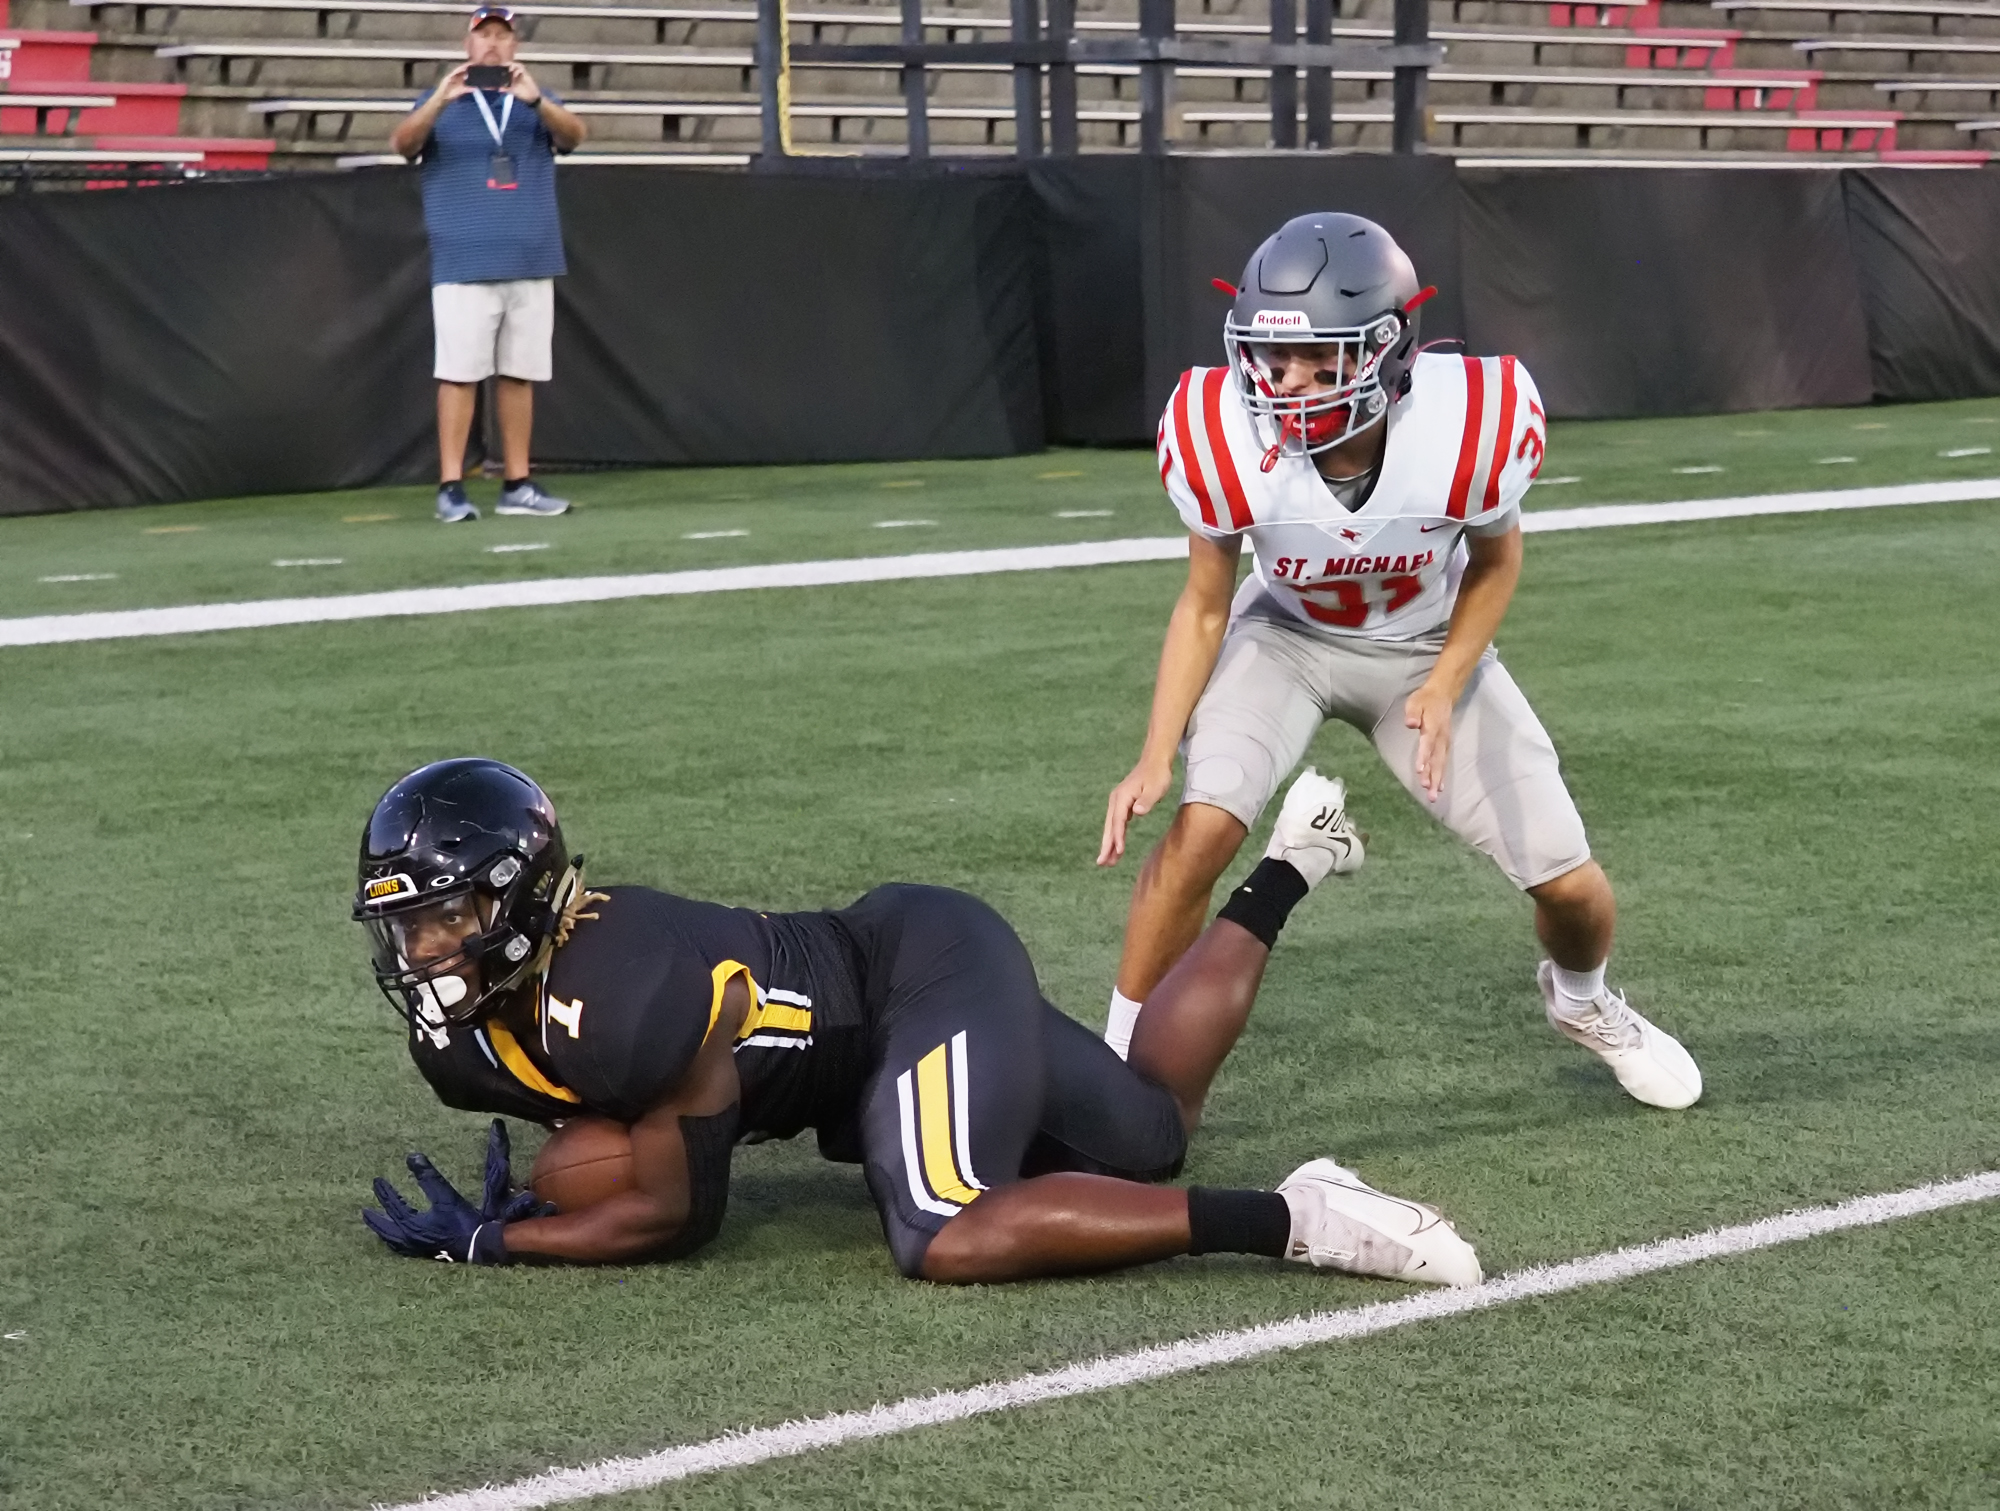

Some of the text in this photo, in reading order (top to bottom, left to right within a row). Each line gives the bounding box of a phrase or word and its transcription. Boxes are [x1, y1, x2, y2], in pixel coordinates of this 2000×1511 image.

[1257, 314, 1301, 326] Riddell
[1272, 556, 1312, 580] ST.
[368, 879, 400, 898] LIONS
